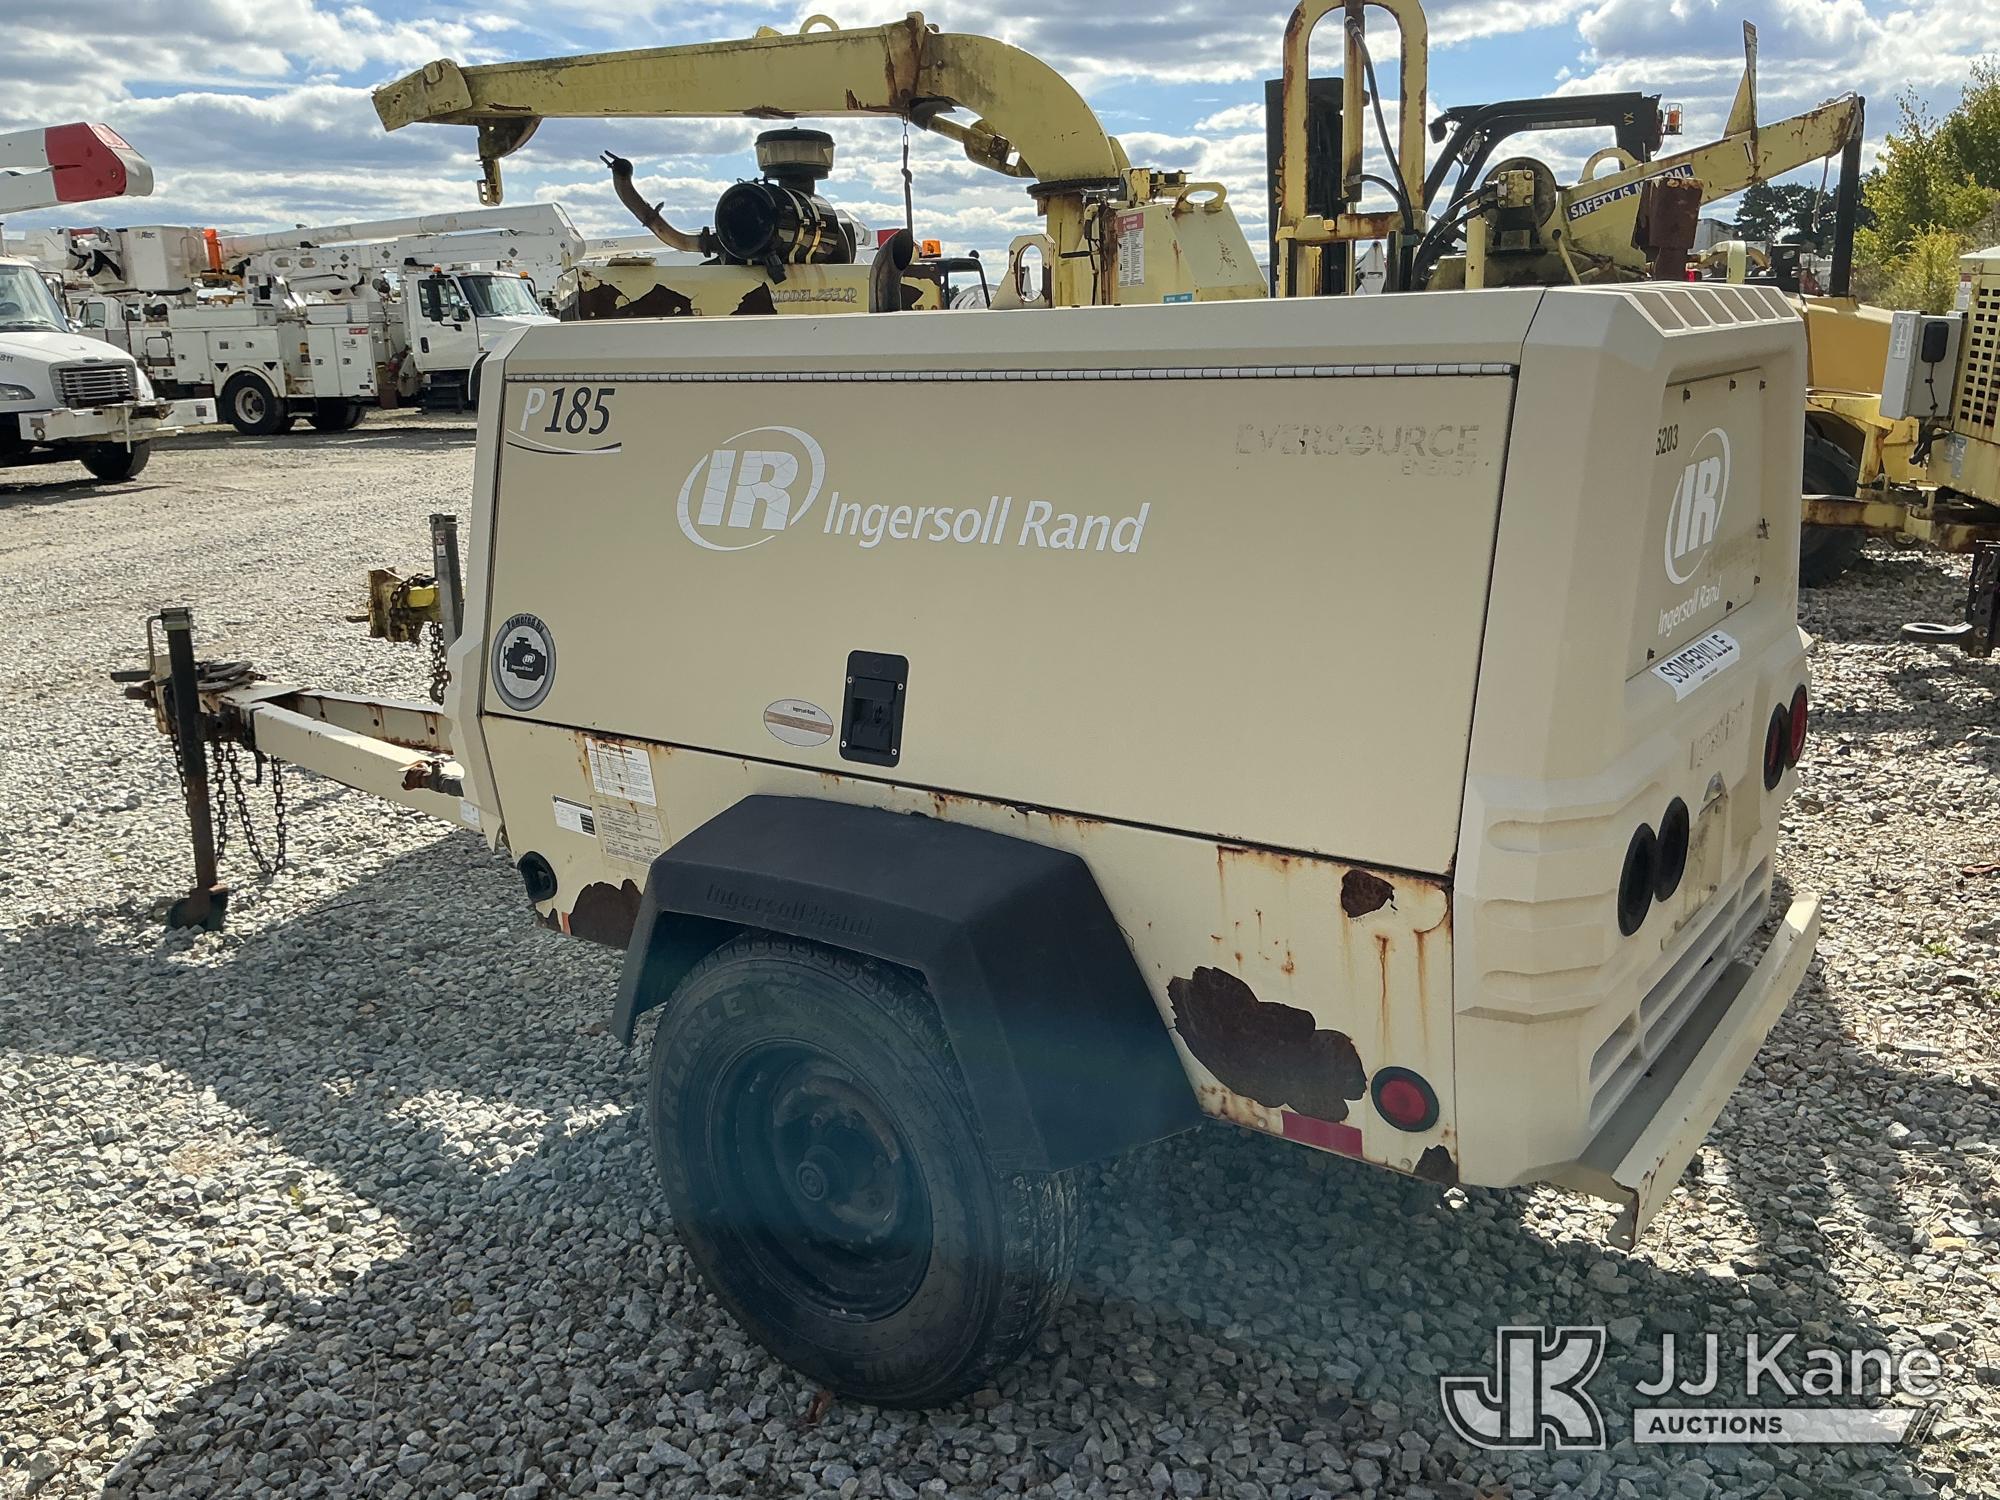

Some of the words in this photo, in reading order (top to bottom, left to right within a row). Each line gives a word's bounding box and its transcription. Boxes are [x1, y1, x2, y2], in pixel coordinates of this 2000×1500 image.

[1570, 191, 1616, 219] SAFETY
[1618, 186, 1631, 199] IS
[770, 288, 813, 304] MODEL
[519, 386, 616, 436] P185
[1236, 422, 1480, 457] EVERSOURCE
[698, 449, 799, 531] IR
[823, 491, 1012, 549] Ingersoll
[1017, 500, 1151, 553] Rand
[1657, 587, 1699, 638] Ingersoll
[1697, 573, 1722, 614] Rand
[1659, 634, 1735, 684] SOMERVILLE
